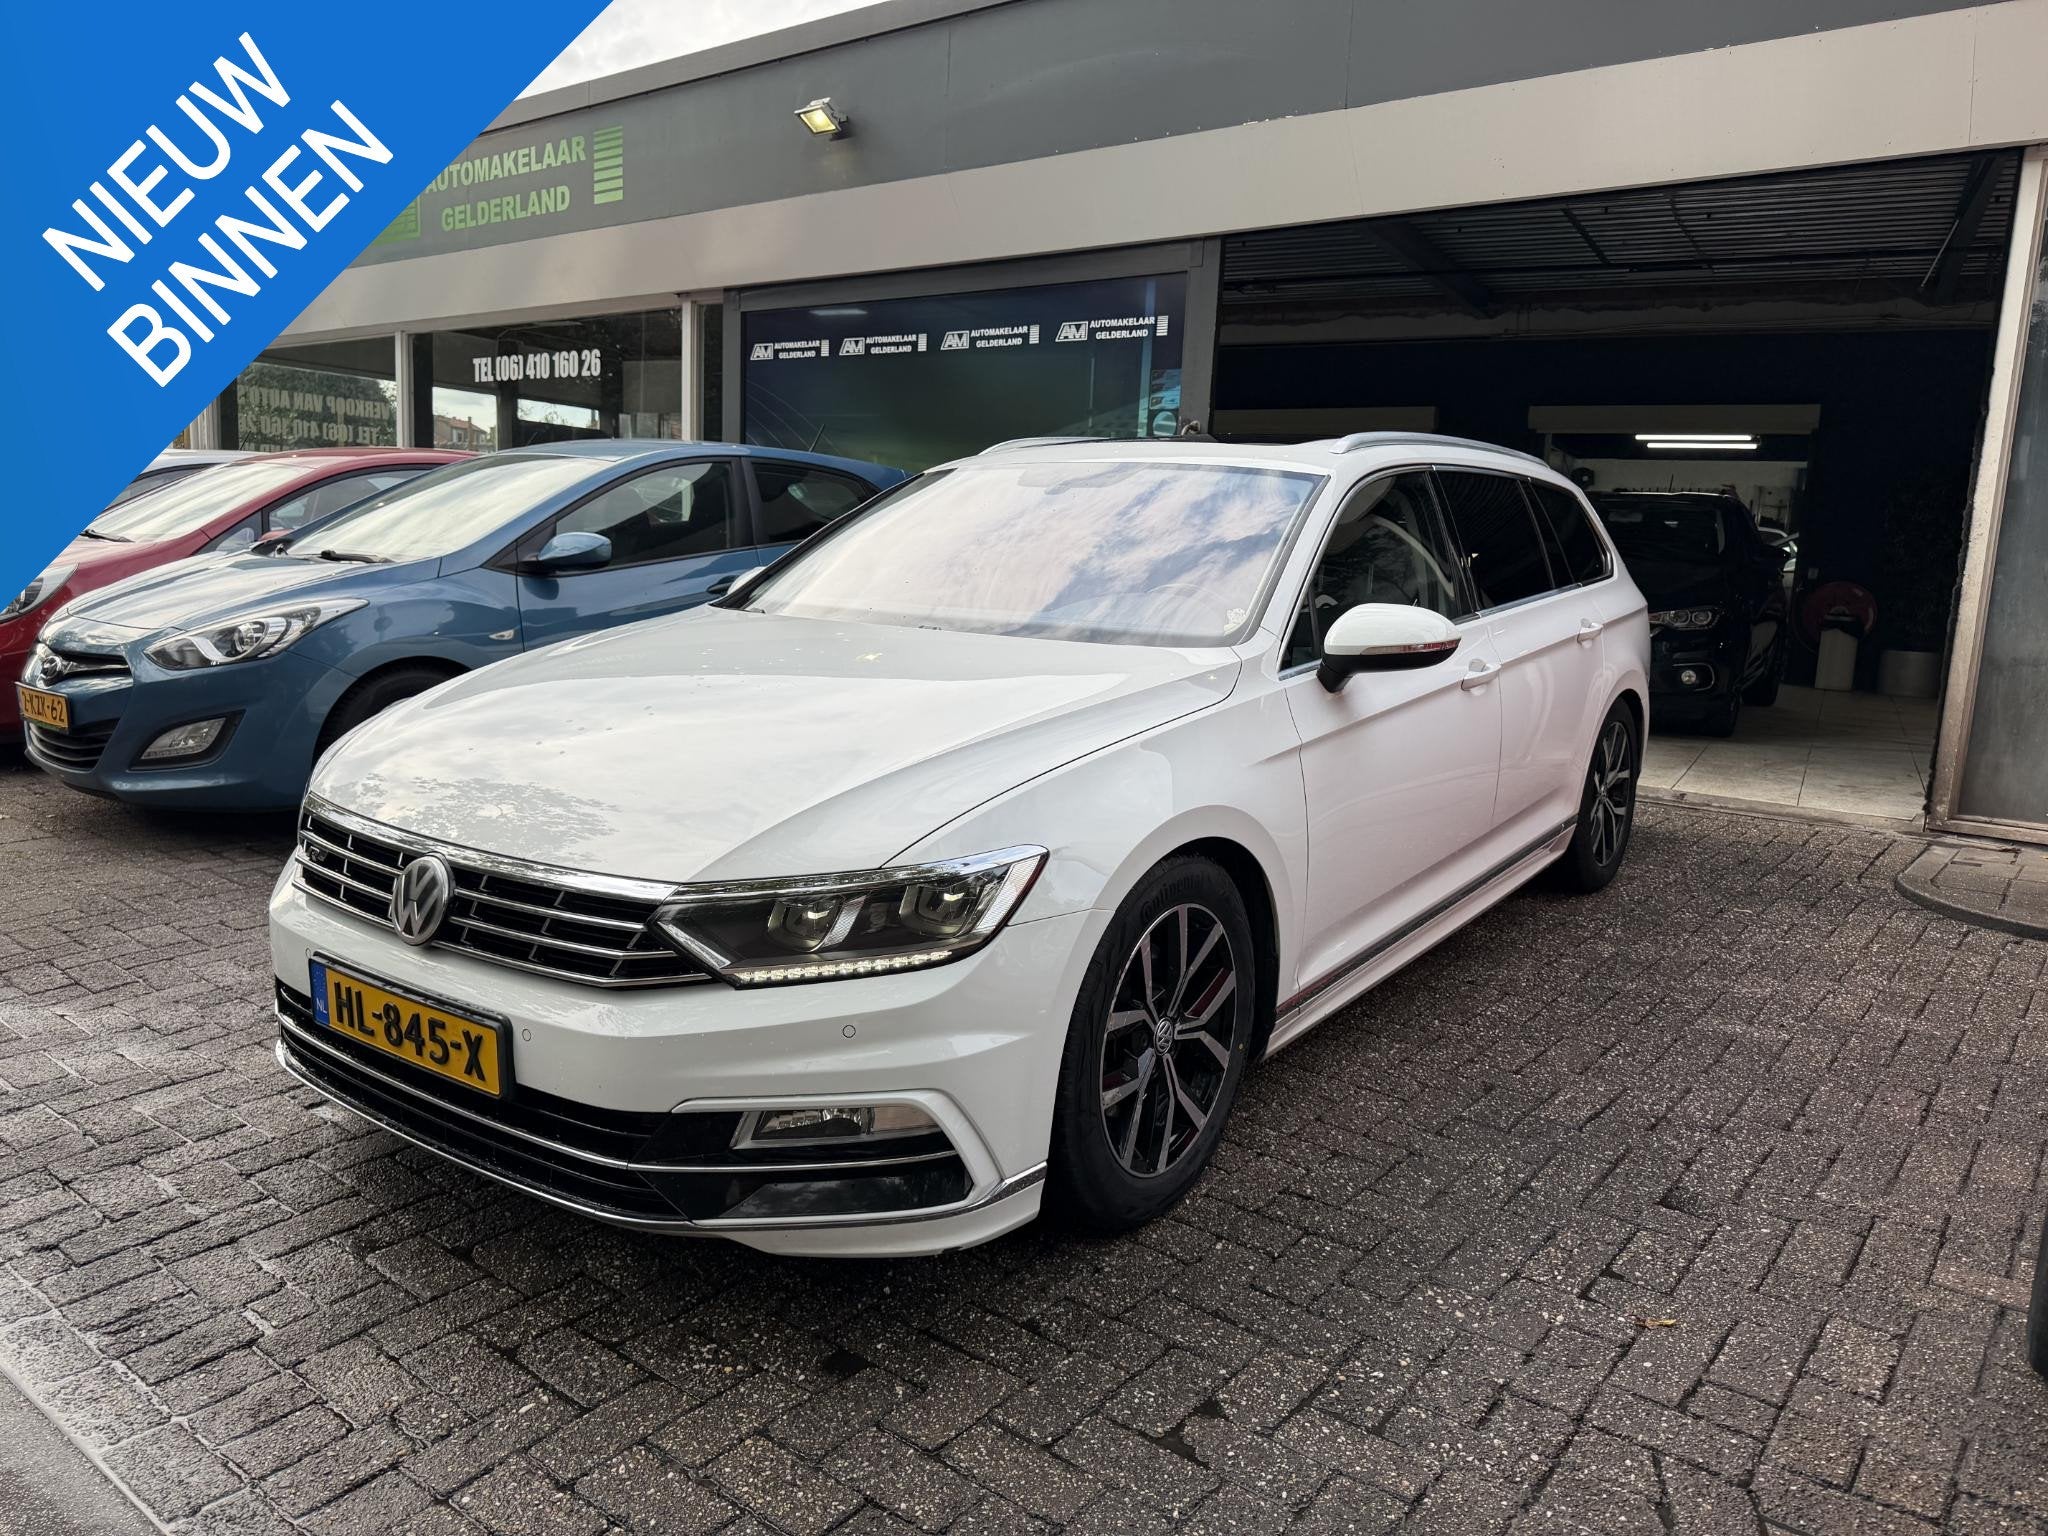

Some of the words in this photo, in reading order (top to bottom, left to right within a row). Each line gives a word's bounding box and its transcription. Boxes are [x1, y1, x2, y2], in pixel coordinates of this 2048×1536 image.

[441, 185, 570, 232] GELDERLAND
[1089, 316, 1155, 328] AUTOMAKELAAR
[970, 326, 1028, 337] AUTOMAKELAAR
[1095, 329, 1148, 340] GELDERLAND
[774, 340, 820, 349] AUTOMAKELAAR
[866, 334, 917, 344] AUTOMAKELAAR
[976, 338, 1022, 348] GELDERLAND
[778, 350, 816, 359] GELDERLAND
[870, 345, 912, 354] GELDERLAND
[473, 357, 494, 382] TEL
[496, 354, 524, 381] (06)
[525, 352, 550, 379] 410
[552, 350, 579, 378] 160
[581, 348, 601, 377] 26
[316, 997, 328, 1014] NL
[334, 981, 486, 1082] HL-845-X
